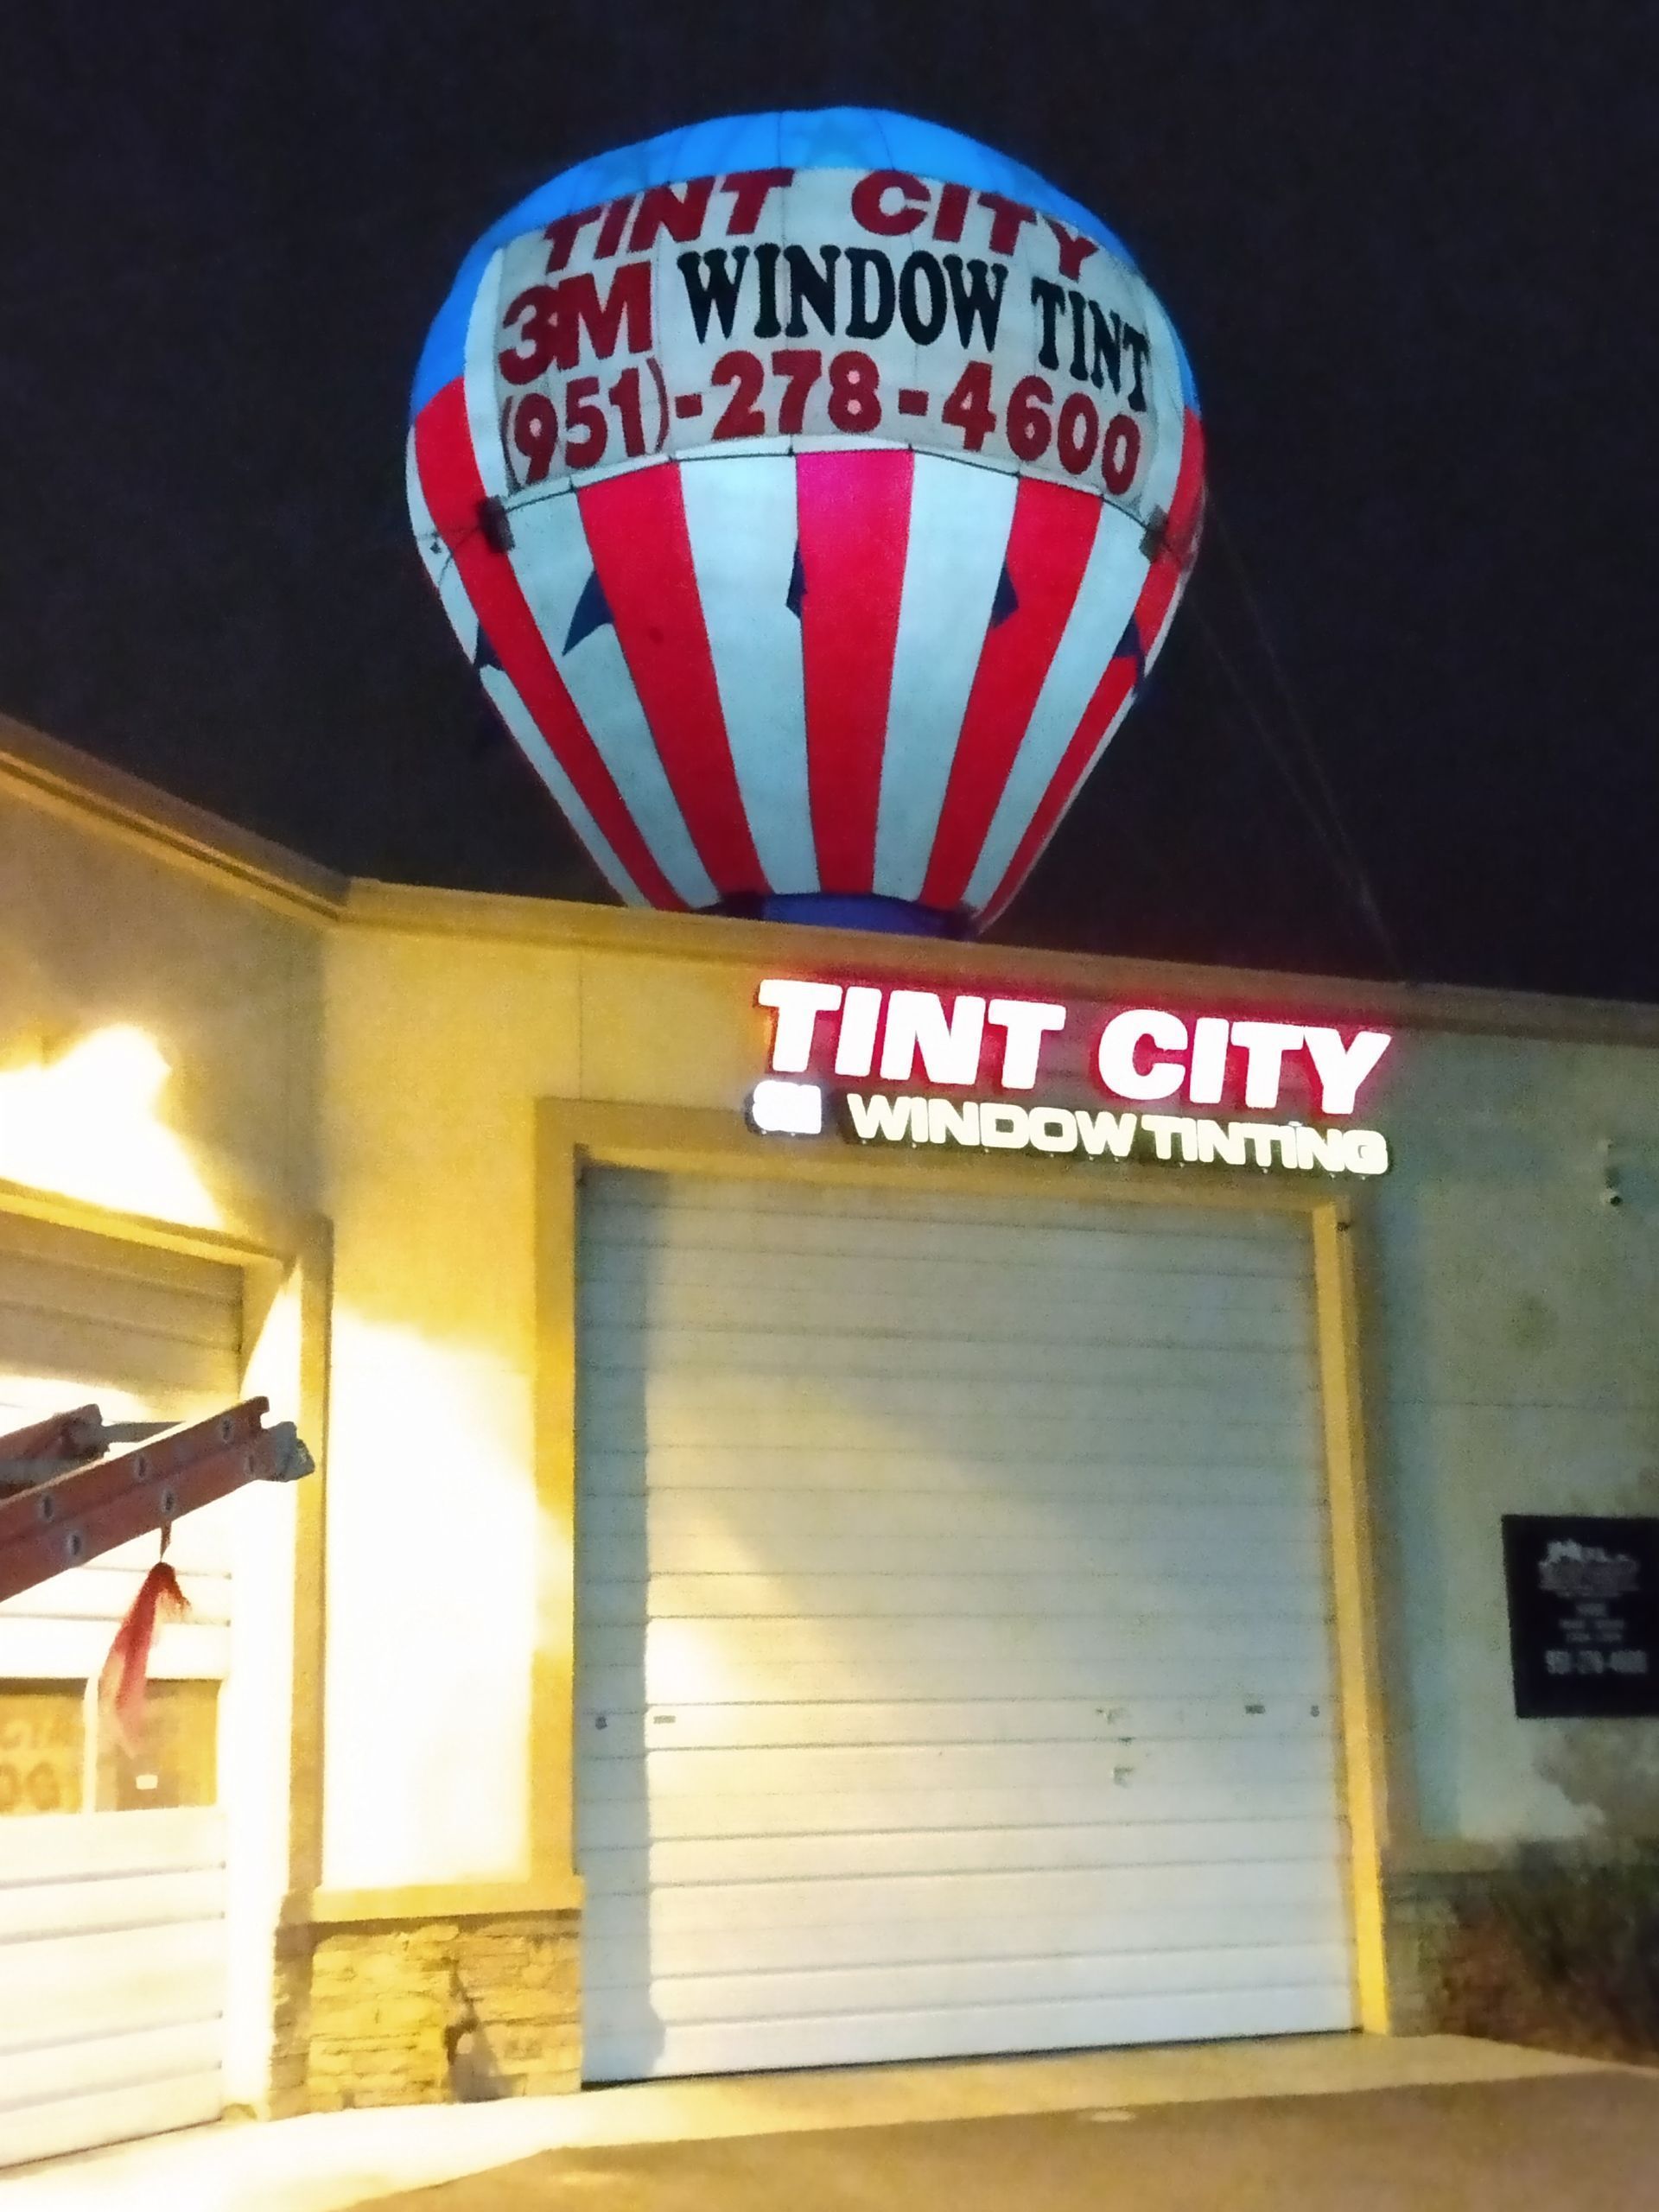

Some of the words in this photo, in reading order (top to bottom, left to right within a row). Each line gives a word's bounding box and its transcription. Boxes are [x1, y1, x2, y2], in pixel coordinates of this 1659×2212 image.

[544, 168, 795, 274] TINT
[851, 169, 1100, 282] CITY
[498, 261, 653, 385] 3M
[677, 243, 1008, 353] WINDOW
[1031, 276, 1152, 413] TINT
[757, 979, 1066, 1090] TINT
[1097, 1008, 1392, 1116] CITY
[847, 1092, 1136, 1157] WINDOW
[1140, 1114, 1389, 1175] TINTING
